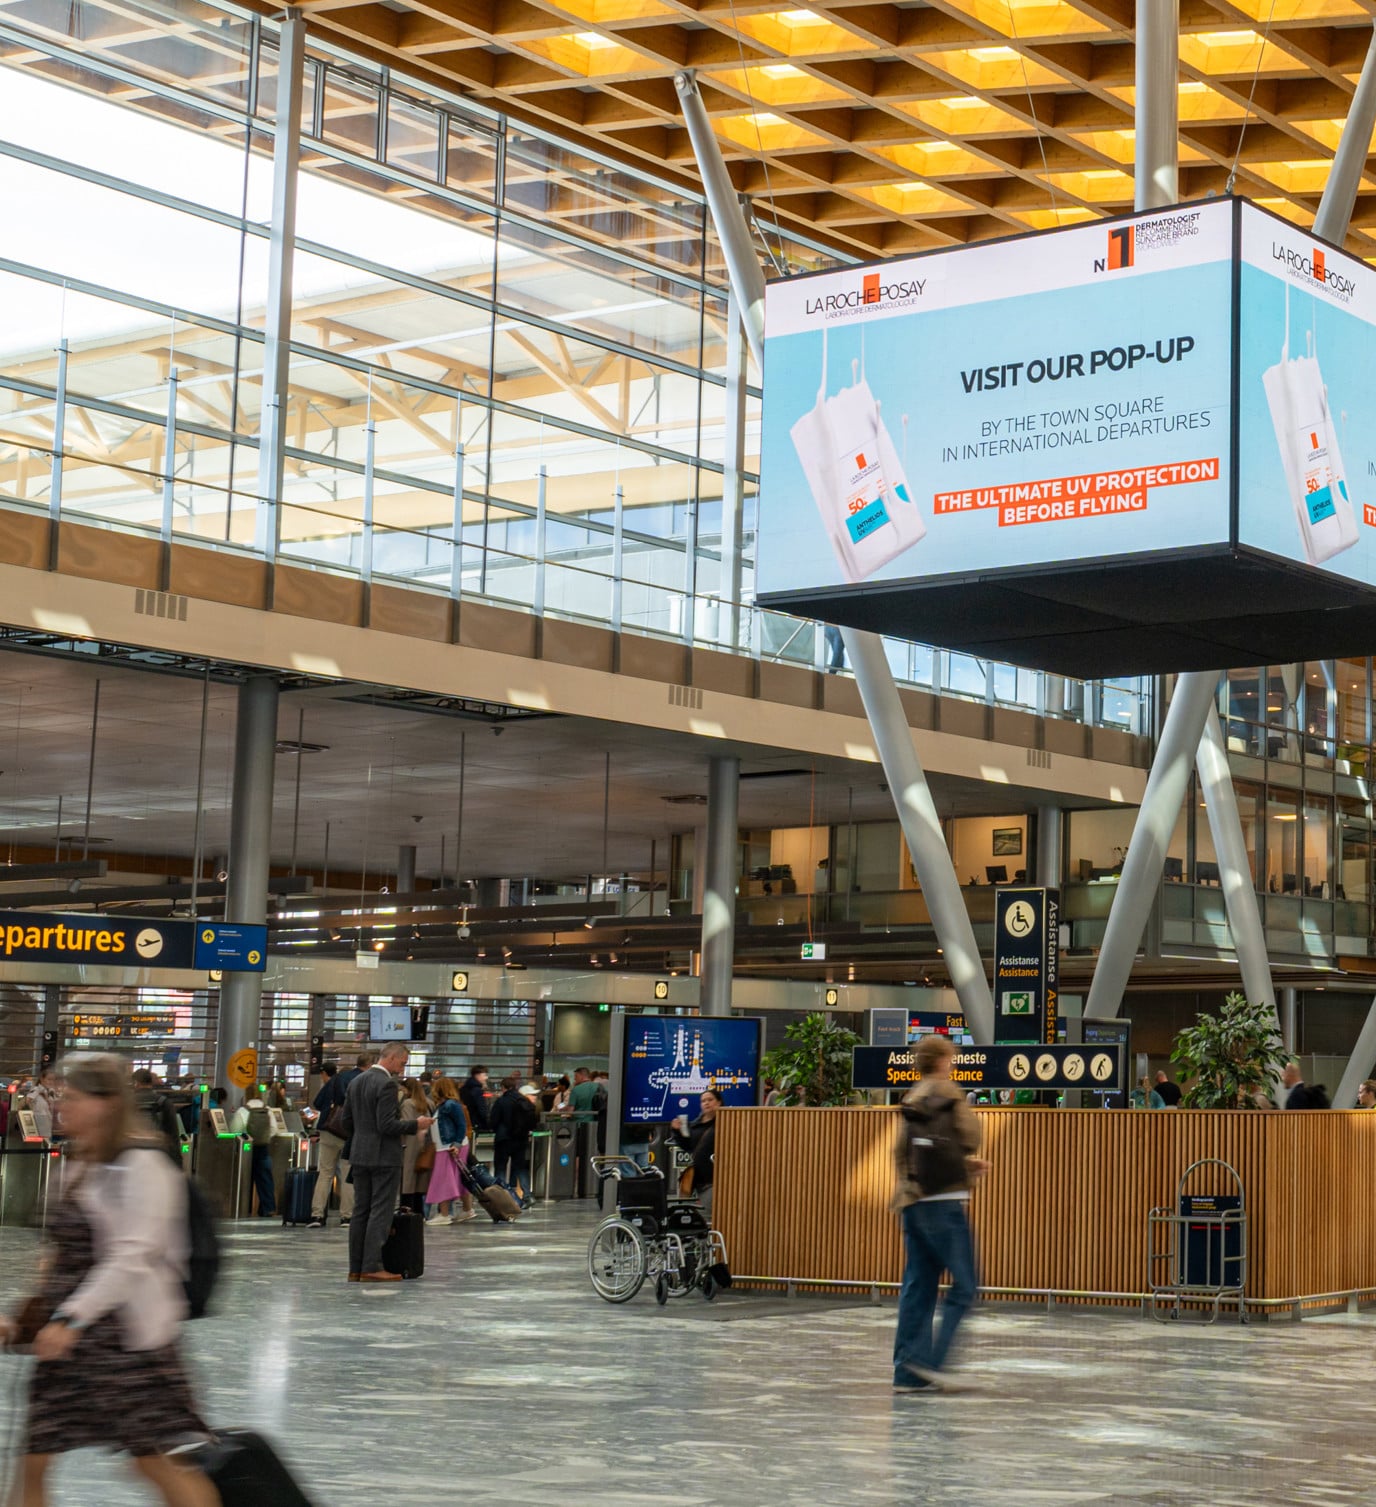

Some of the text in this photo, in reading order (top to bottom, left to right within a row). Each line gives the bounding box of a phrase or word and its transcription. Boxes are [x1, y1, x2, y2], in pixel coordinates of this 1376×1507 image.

[1135, 212, 1201, 232] DERMATOLOGIST
[1172, 227, 1200, 239] BRAND
[1272, 241, 1356, 297] LA ROCHE POSAY
[805, 279, 927, 315] LA ROCHE POSAY
[960, 335, 1195, 394] VISIT OUR POP-UP
[981, 396, 1165, 437] BY THE TOWN SQUARE
[942, 410, 1211, 463] IN INTERNATIONAL DEPARTURES
[938, 461, 1215, 511] THE ULTIMATE UV PROTECTION
[1003, 491, 1144, 524] BEFORE FLYING
[1047, 900, 1059, 983] Assistanse
[999, 967, 1039, 977] Assistance
[1000, 956, 1039, 966] Assistanse
[946, 1015, 963, 1027] Fast
[887, 1067, 921, 1085] Specia
